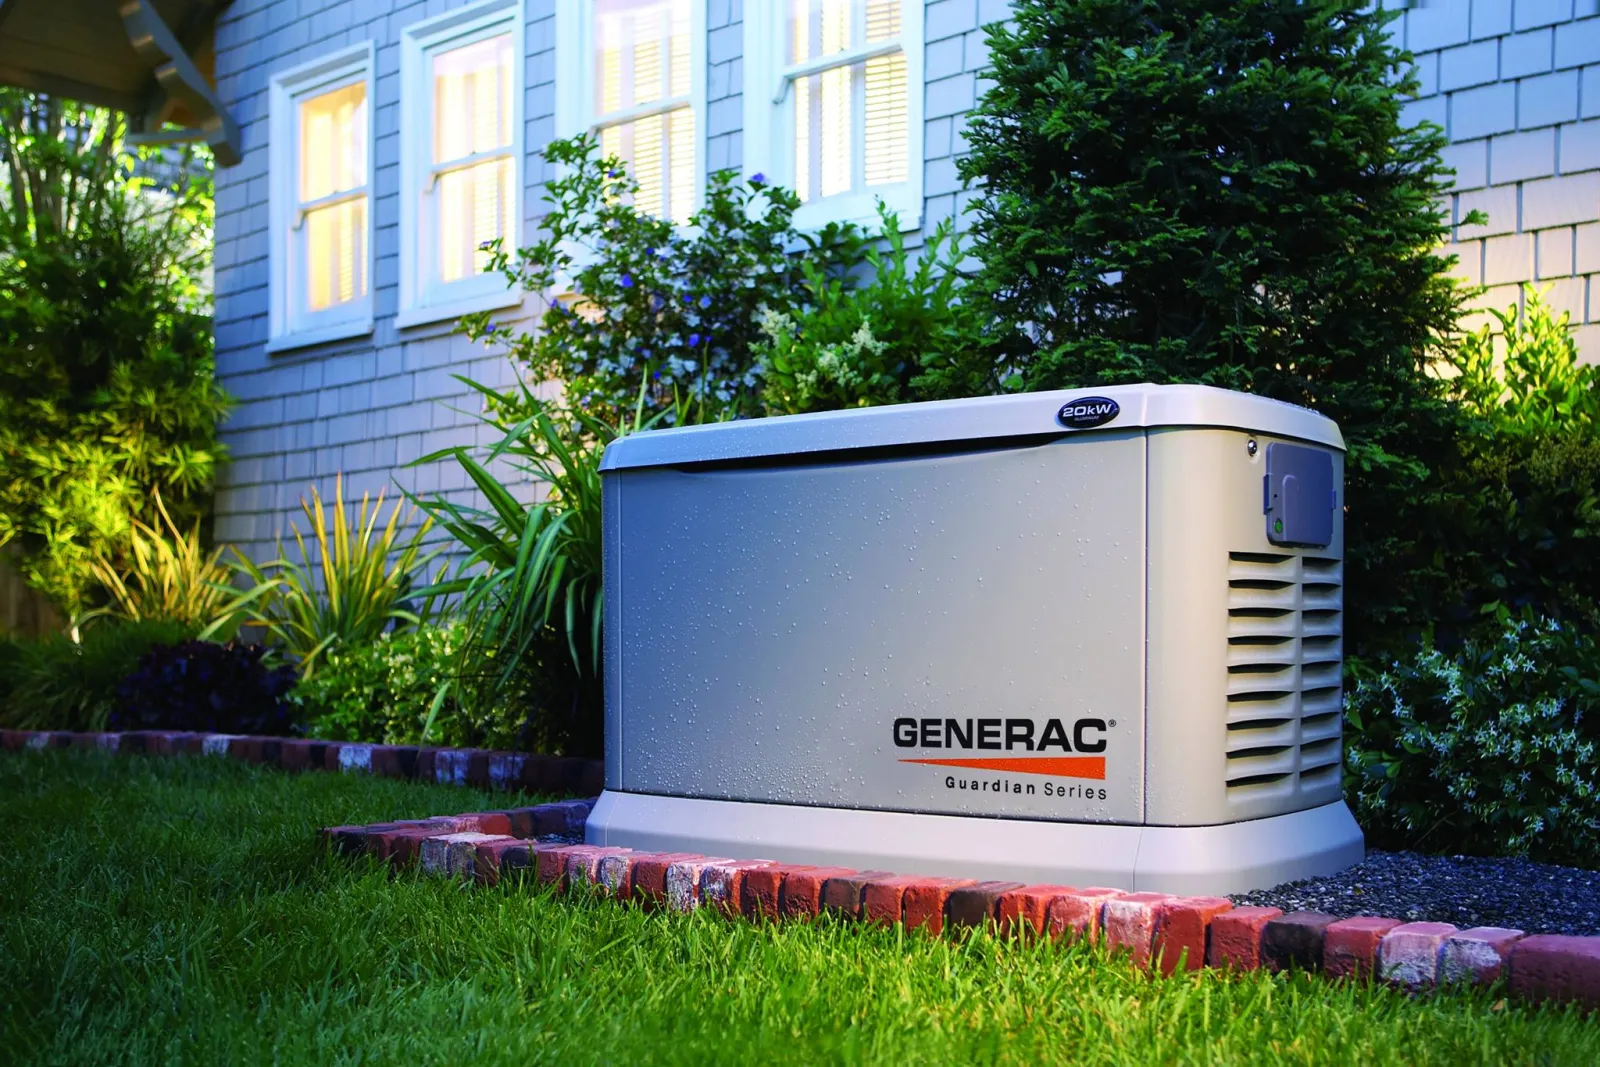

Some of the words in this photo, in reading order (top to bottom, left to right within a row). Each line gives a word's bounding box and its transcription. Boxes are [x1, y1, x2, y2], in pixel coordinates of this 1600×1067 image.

[1062, 403, 1112, 417] 20kW
[893, 718, 1107, 753] GENERAC
[945, 776, 1036, 795] Guardian
[1044, 782, 1107, 800] Series
